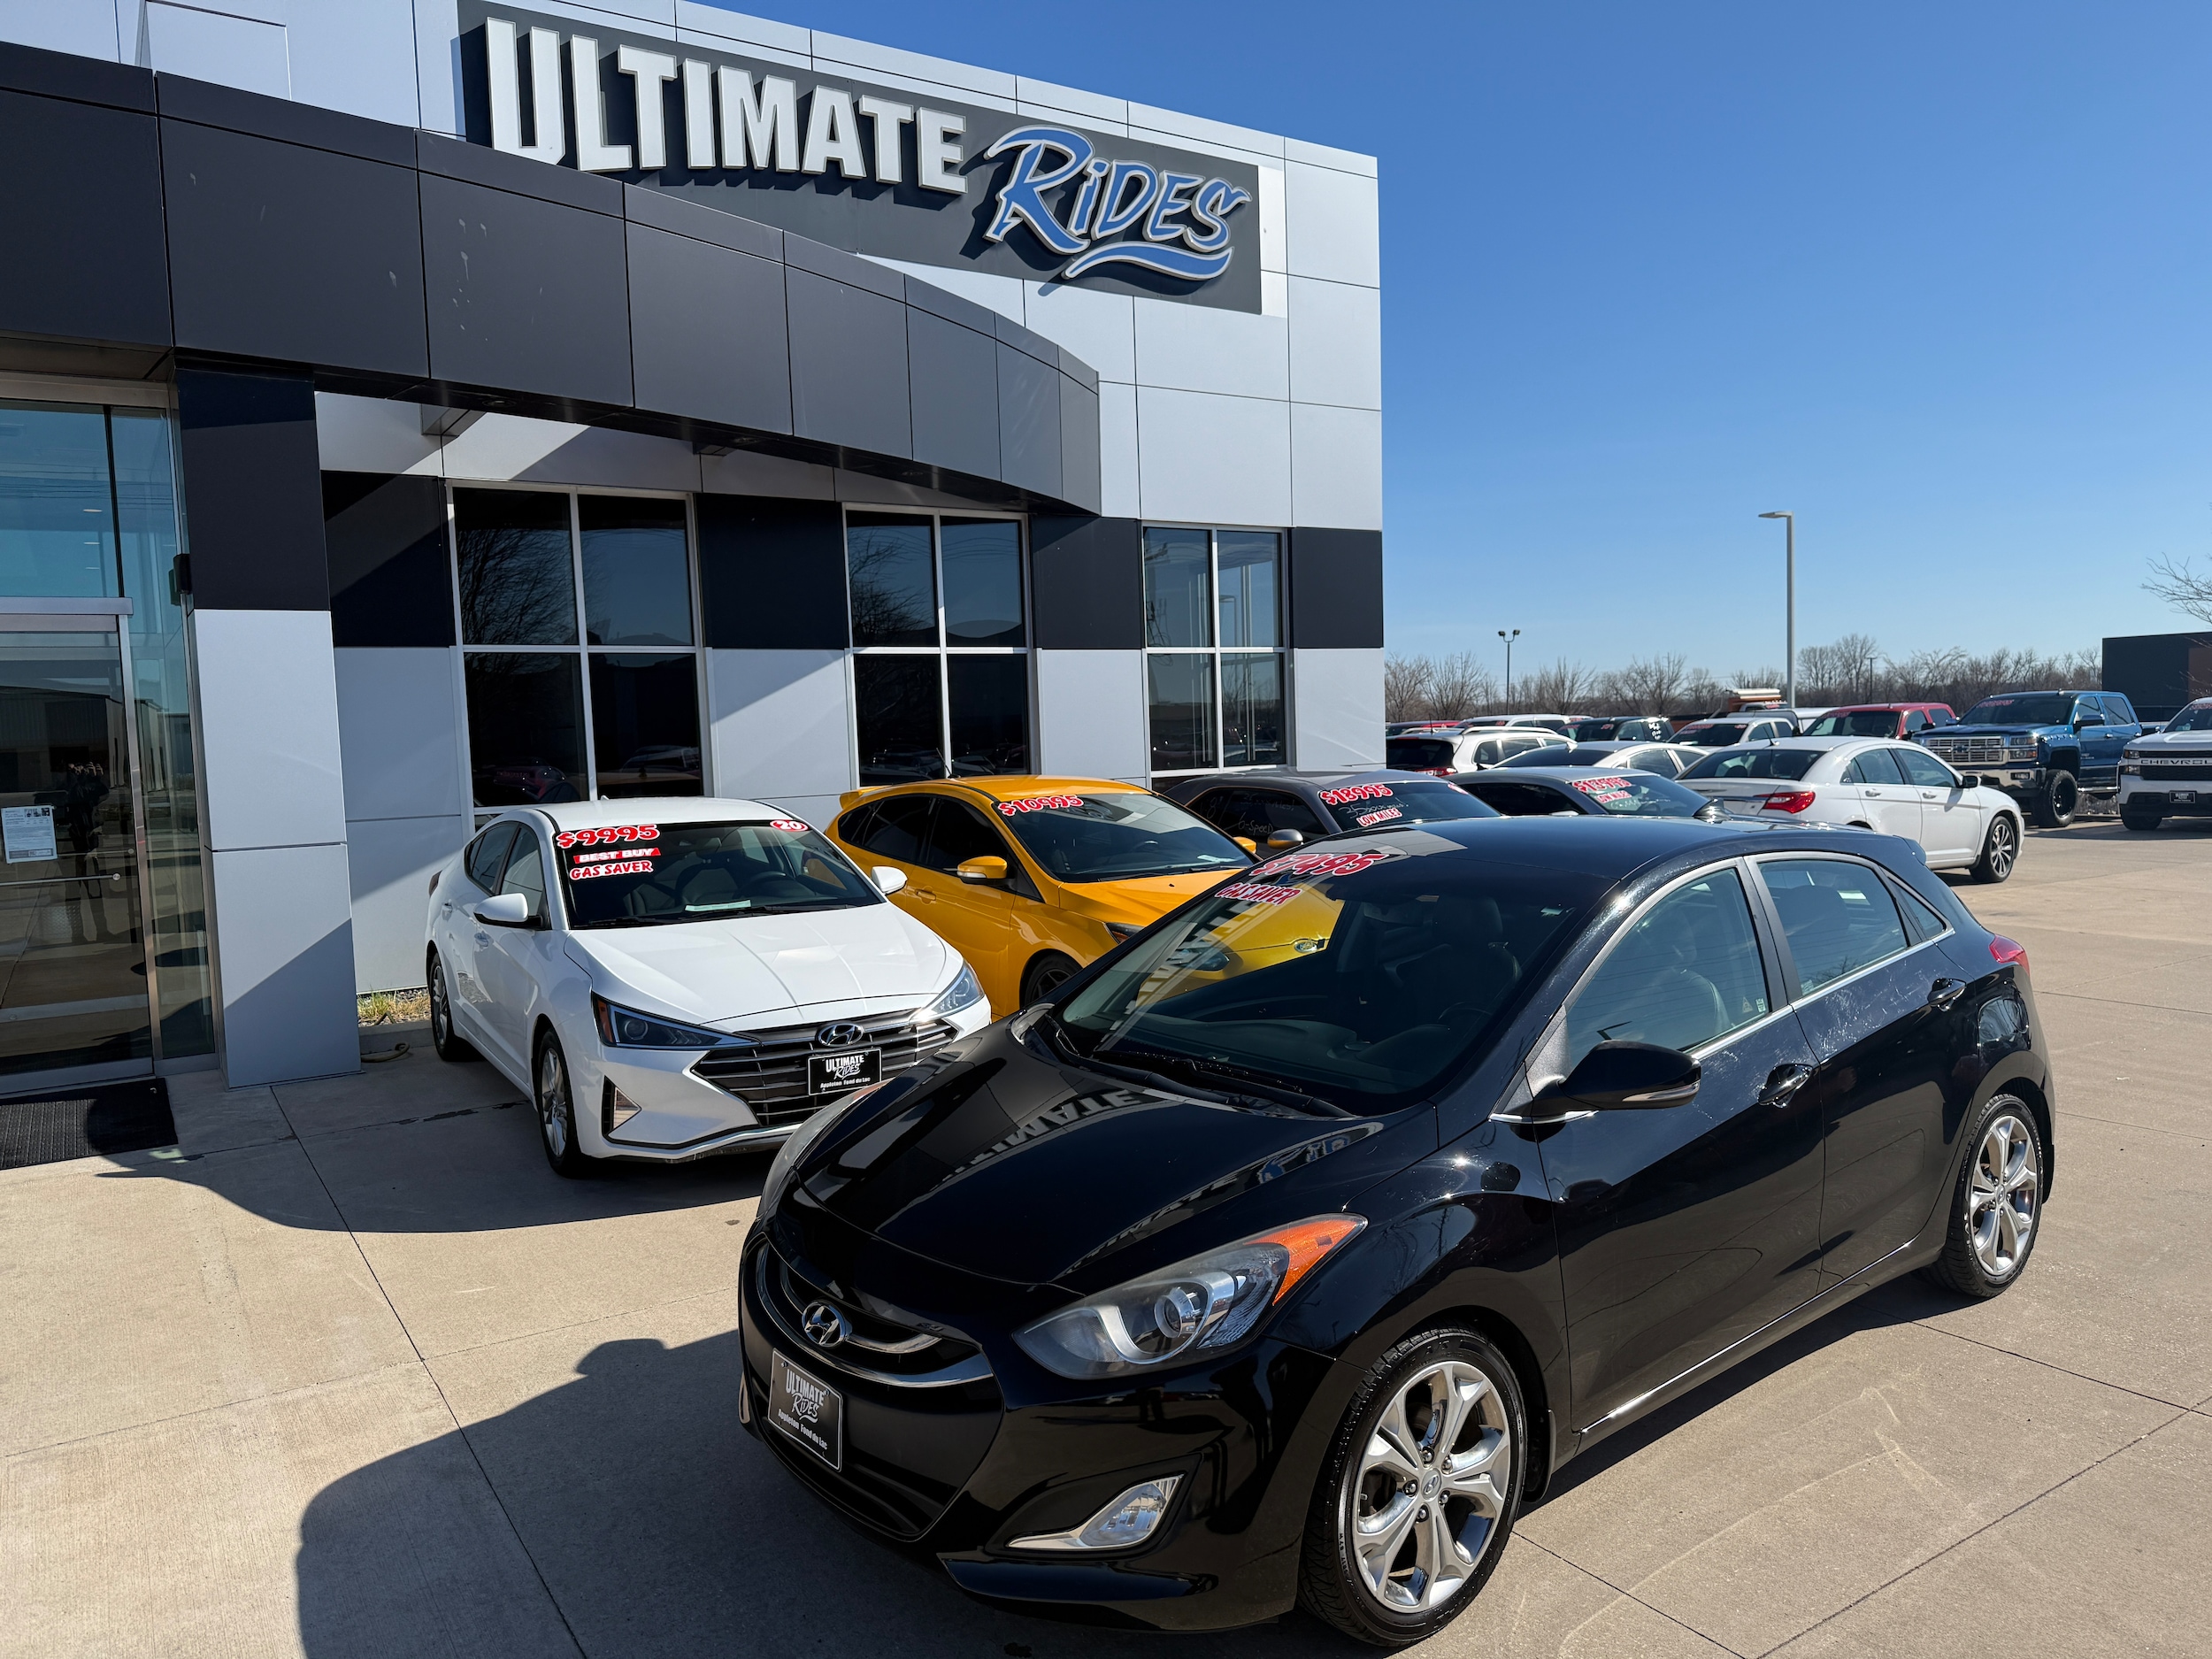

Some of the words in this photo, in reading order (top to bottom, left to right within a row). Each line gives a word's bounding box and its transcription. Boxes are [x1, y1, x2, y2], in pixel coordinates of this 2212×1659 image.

[484, 16, 969, 194] ULTIMATE
[1318, 784, 1394, 805] $18995
[998, 795, 1084, 816] $10995
[1356, 813, 1378, 826] LOW
[1376, 808, 1402, 821] MILES
[556, 825, 660, 848] $9995
[580, 850, 619, 863] BEST
[621, 848, 654, 857] BUY
[570, 866, 601, 880] GAS
[603, 860, 654, 875] SAVER
[1240, 884, 1302, 906] SAVER
[826, 1055, 864, 1072] ULTIMATE
[786, 1369, 825, 1406] ULTIMATE
[801, 1424, 812, 1439] Fond
